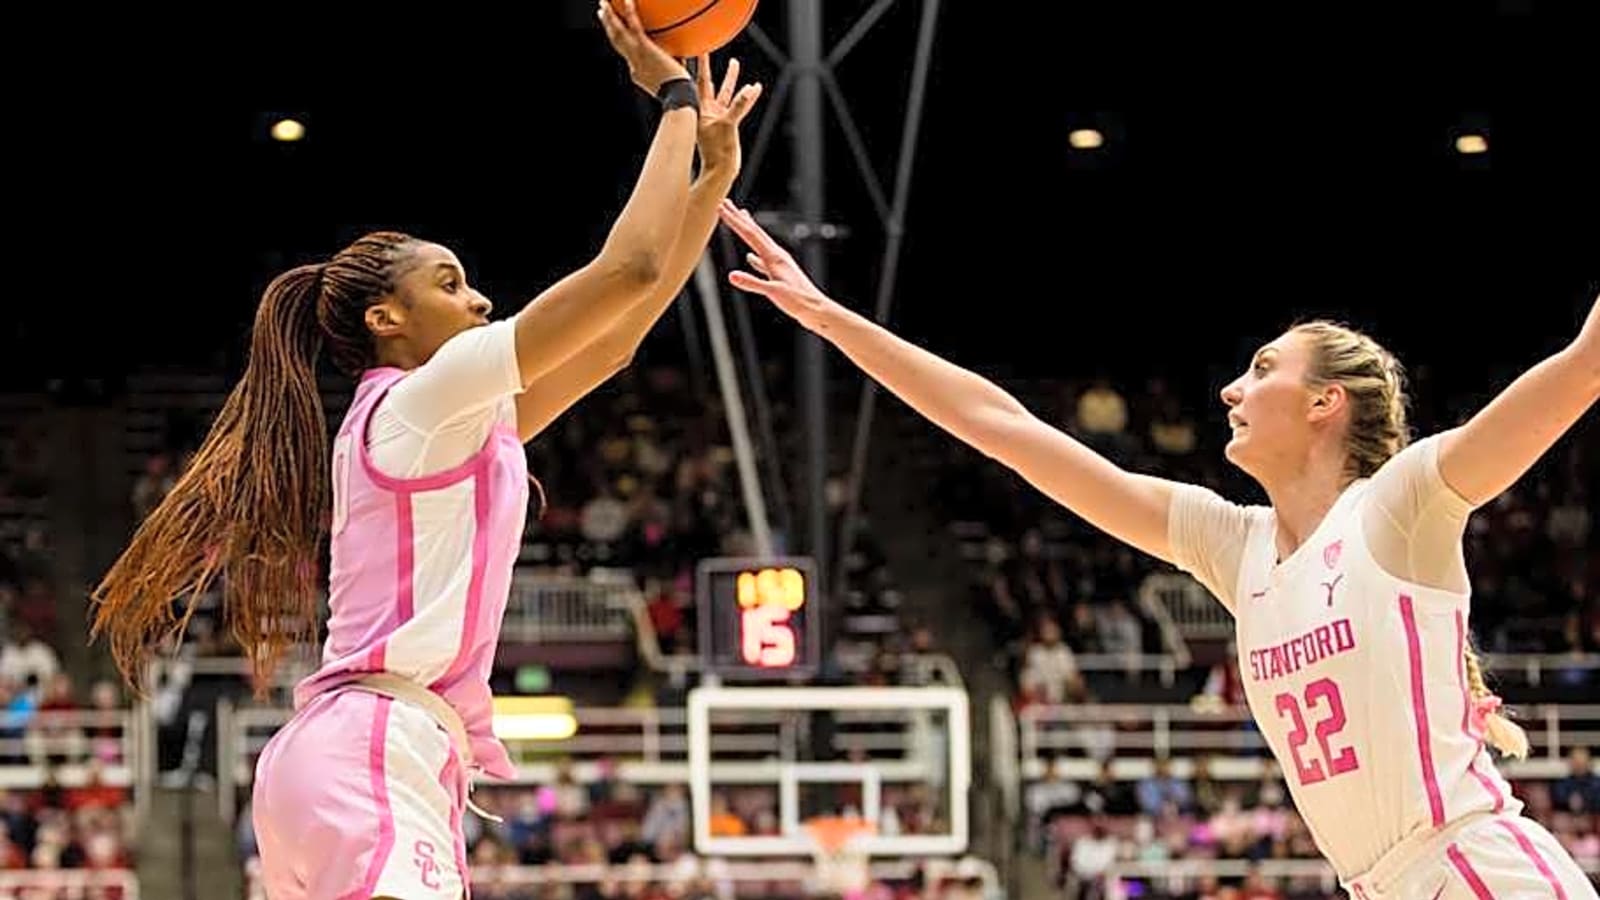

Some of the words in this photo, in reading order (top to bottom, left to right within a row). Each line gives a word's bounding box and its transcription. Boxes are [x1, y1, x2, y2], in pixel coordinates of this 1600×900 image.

[1250, 619, 1355, 681] STANFORD
[1276, 678, 1359, 786] 22
[413, 840, 441, 890] SC
